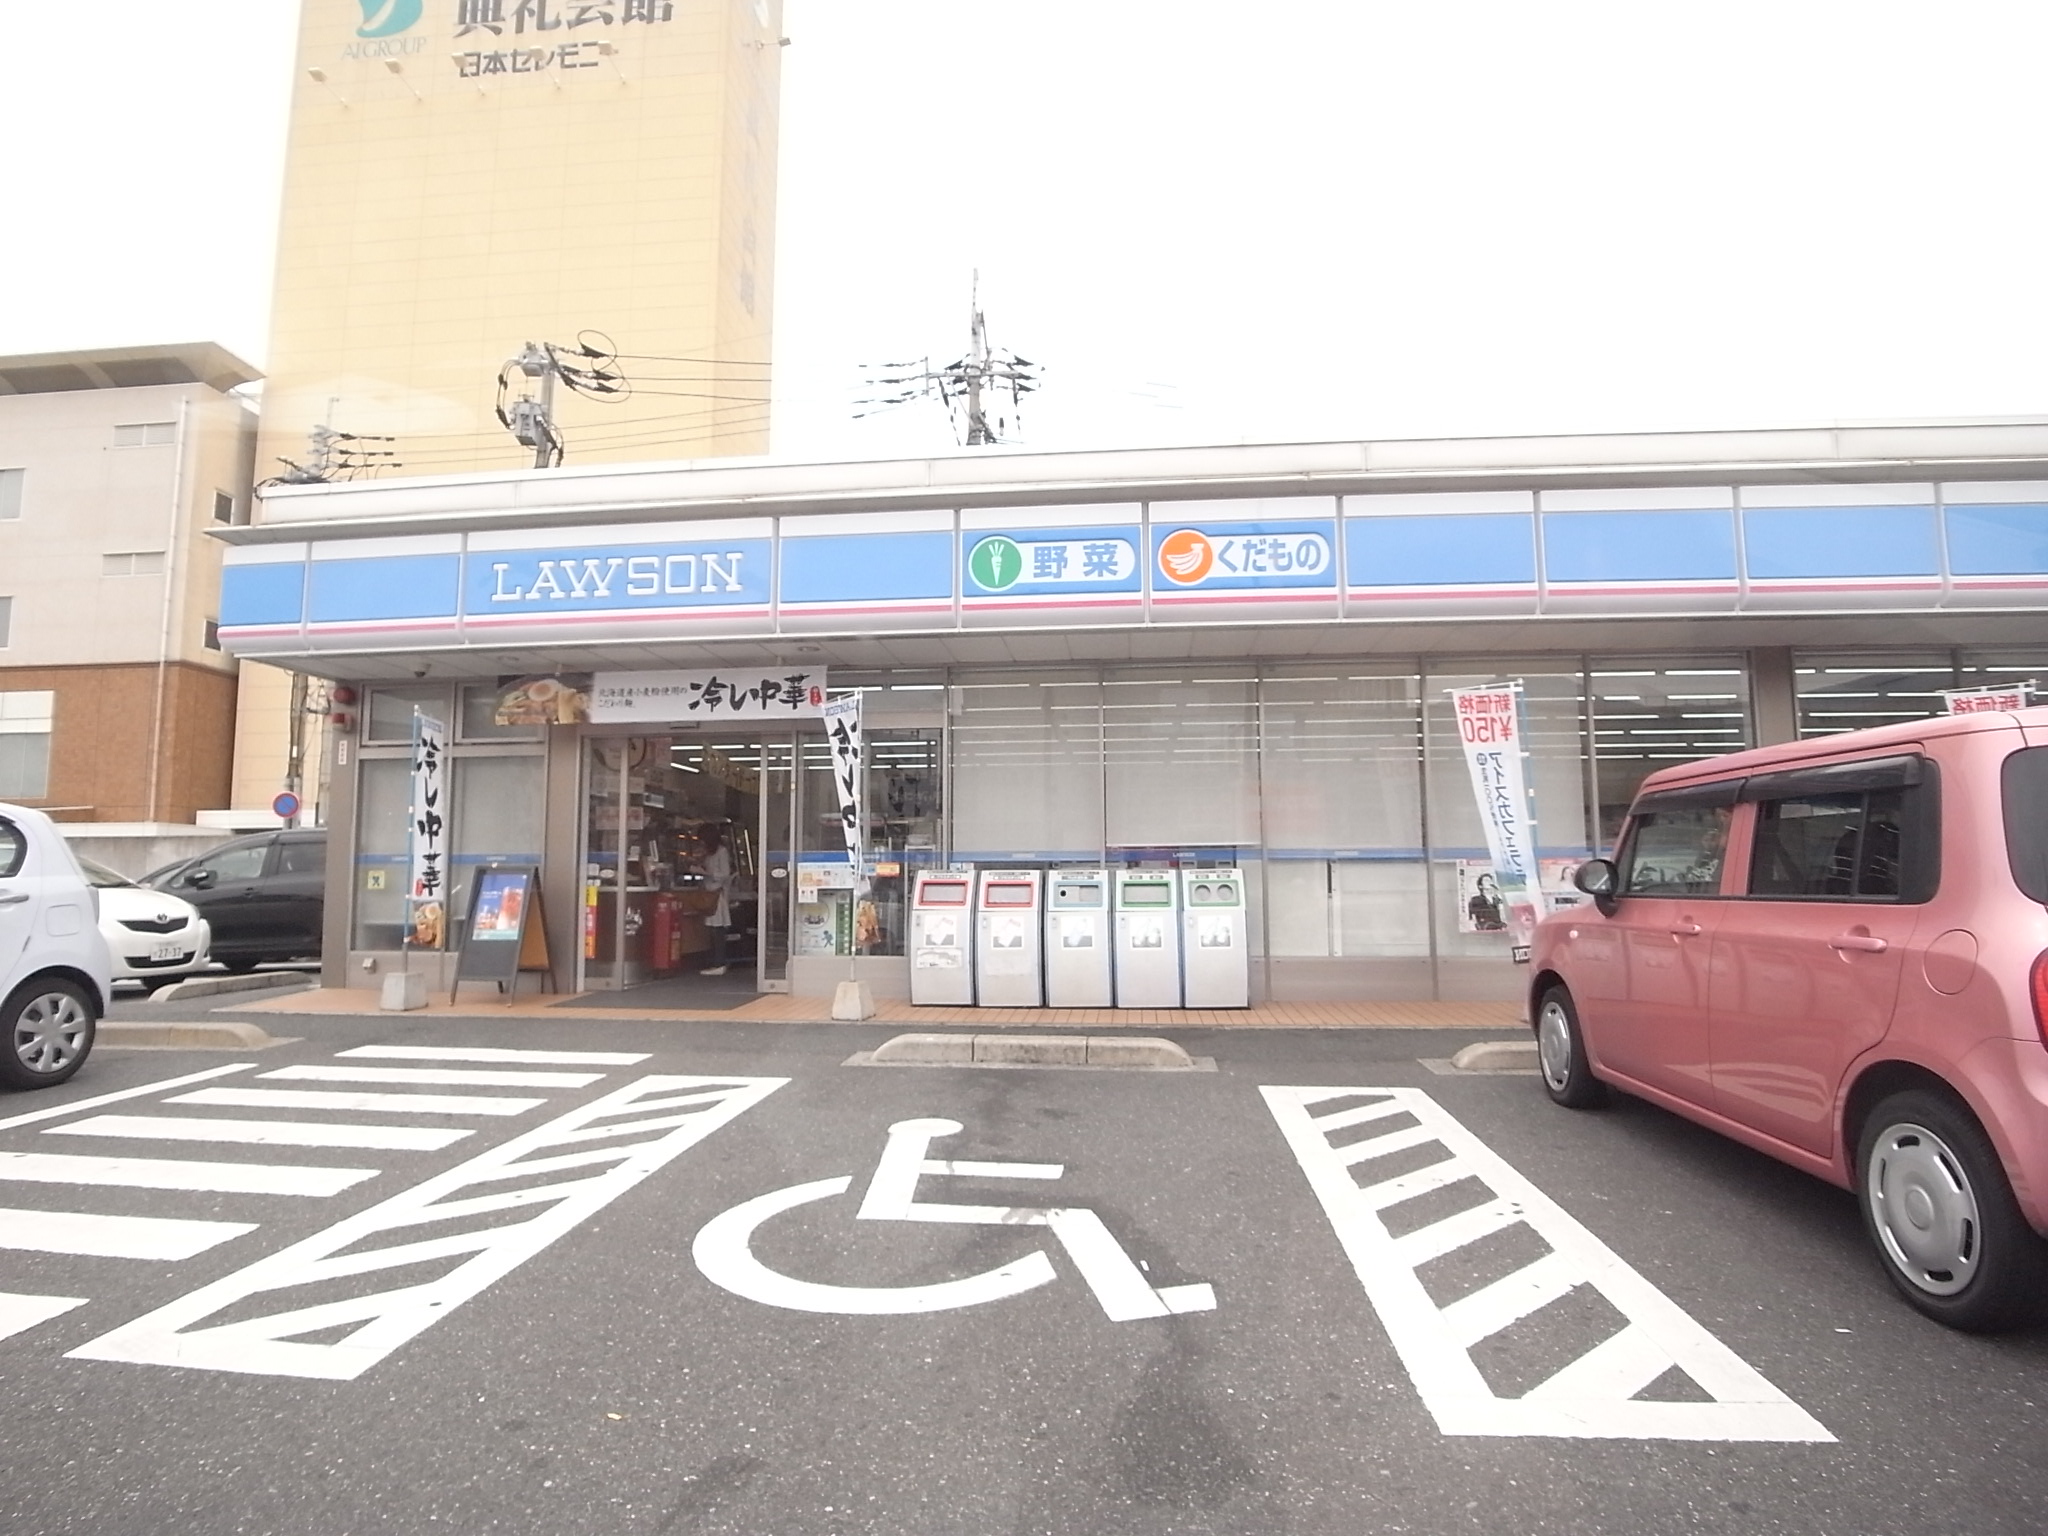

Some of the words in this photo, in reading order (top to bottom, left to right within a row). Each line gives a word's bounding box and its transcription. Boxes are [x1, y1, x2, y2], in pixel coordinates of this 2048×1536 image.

[458, 40, 619, 77] 日本セレモニ
[1032, 543, 1119, 579] 野菜
[1216, 538, 1322, 574] くだもの
[491, 551, 744, 602] LAWSON
[687, 674, 811, 713] 冷し中華
[416, 735, 443, 897] 冷し中華
